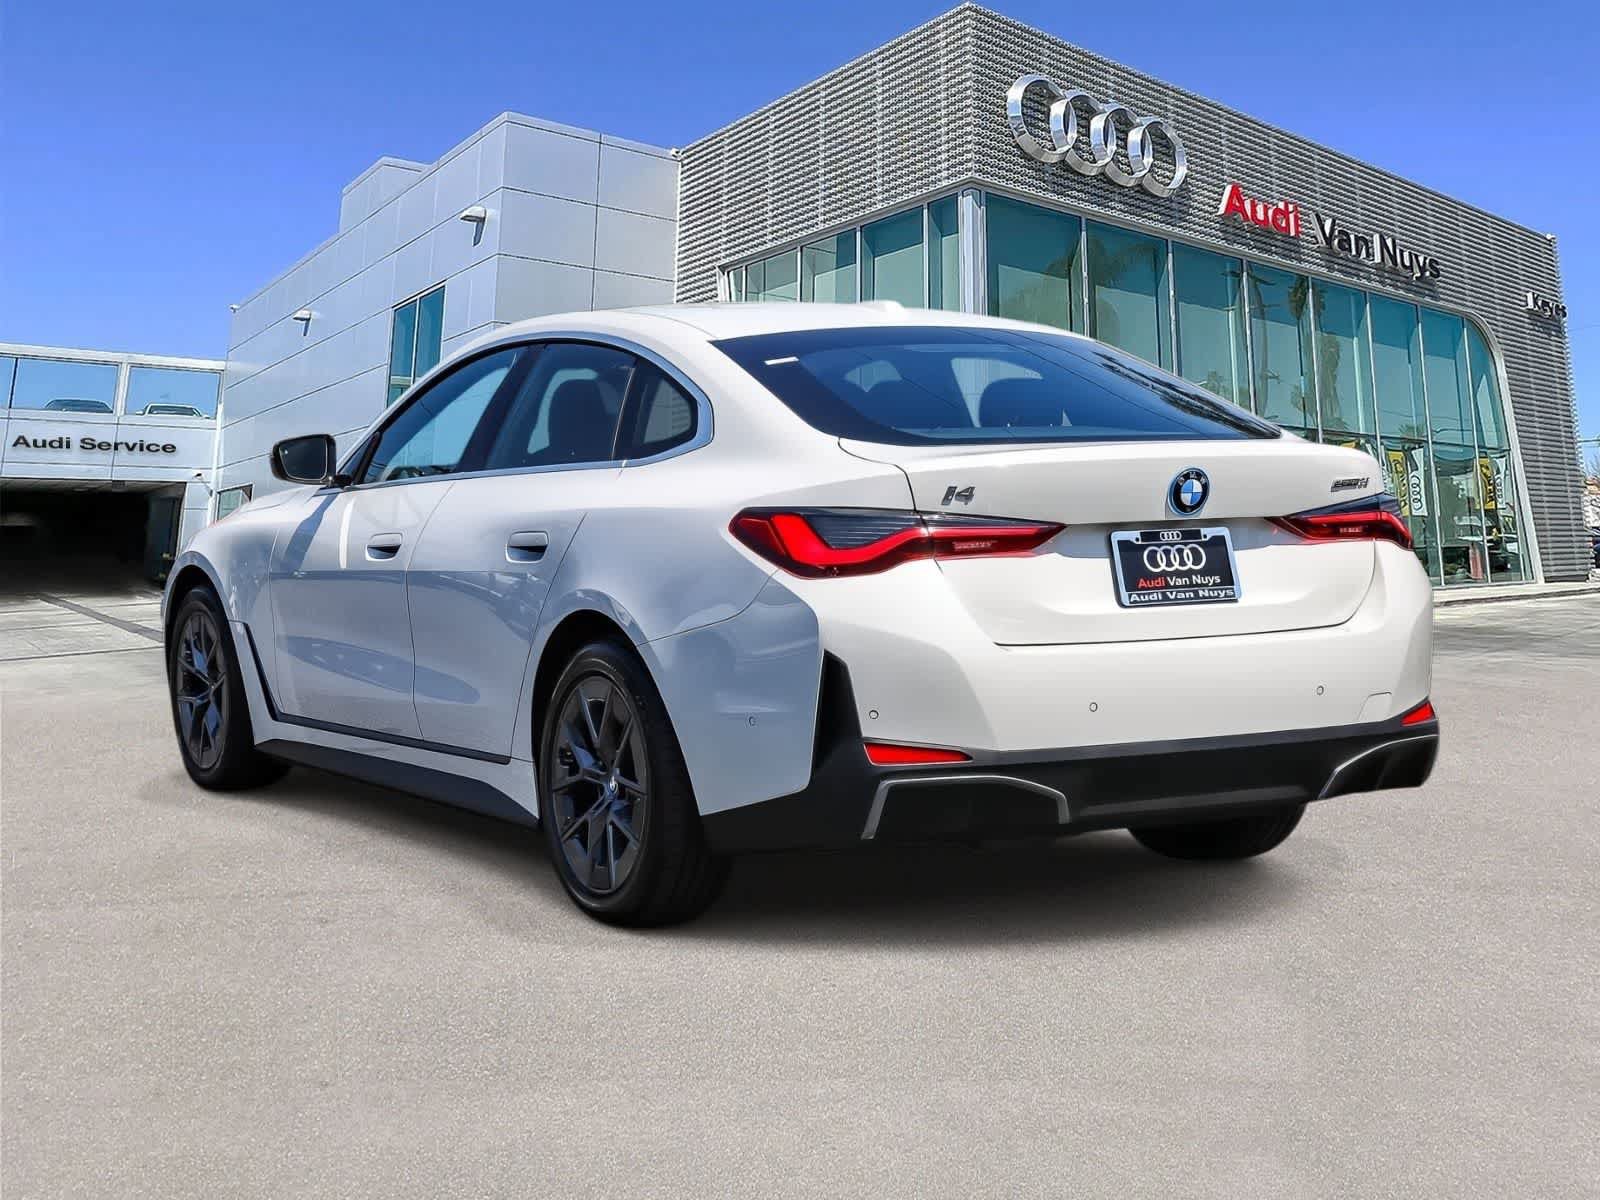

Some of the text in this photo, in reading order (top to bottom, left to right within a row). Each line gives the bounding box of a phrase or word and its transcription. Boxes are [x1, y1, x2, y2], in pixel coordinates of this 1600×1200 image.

[1218, 183, 1441, 281] Audi Van Nuys
[12, 435, 177, 453] Audi Service
[1137, 574, 1221, 589] Audi Van Nuys
[1130, 588, 1234, 602] Audi Van Nuys
